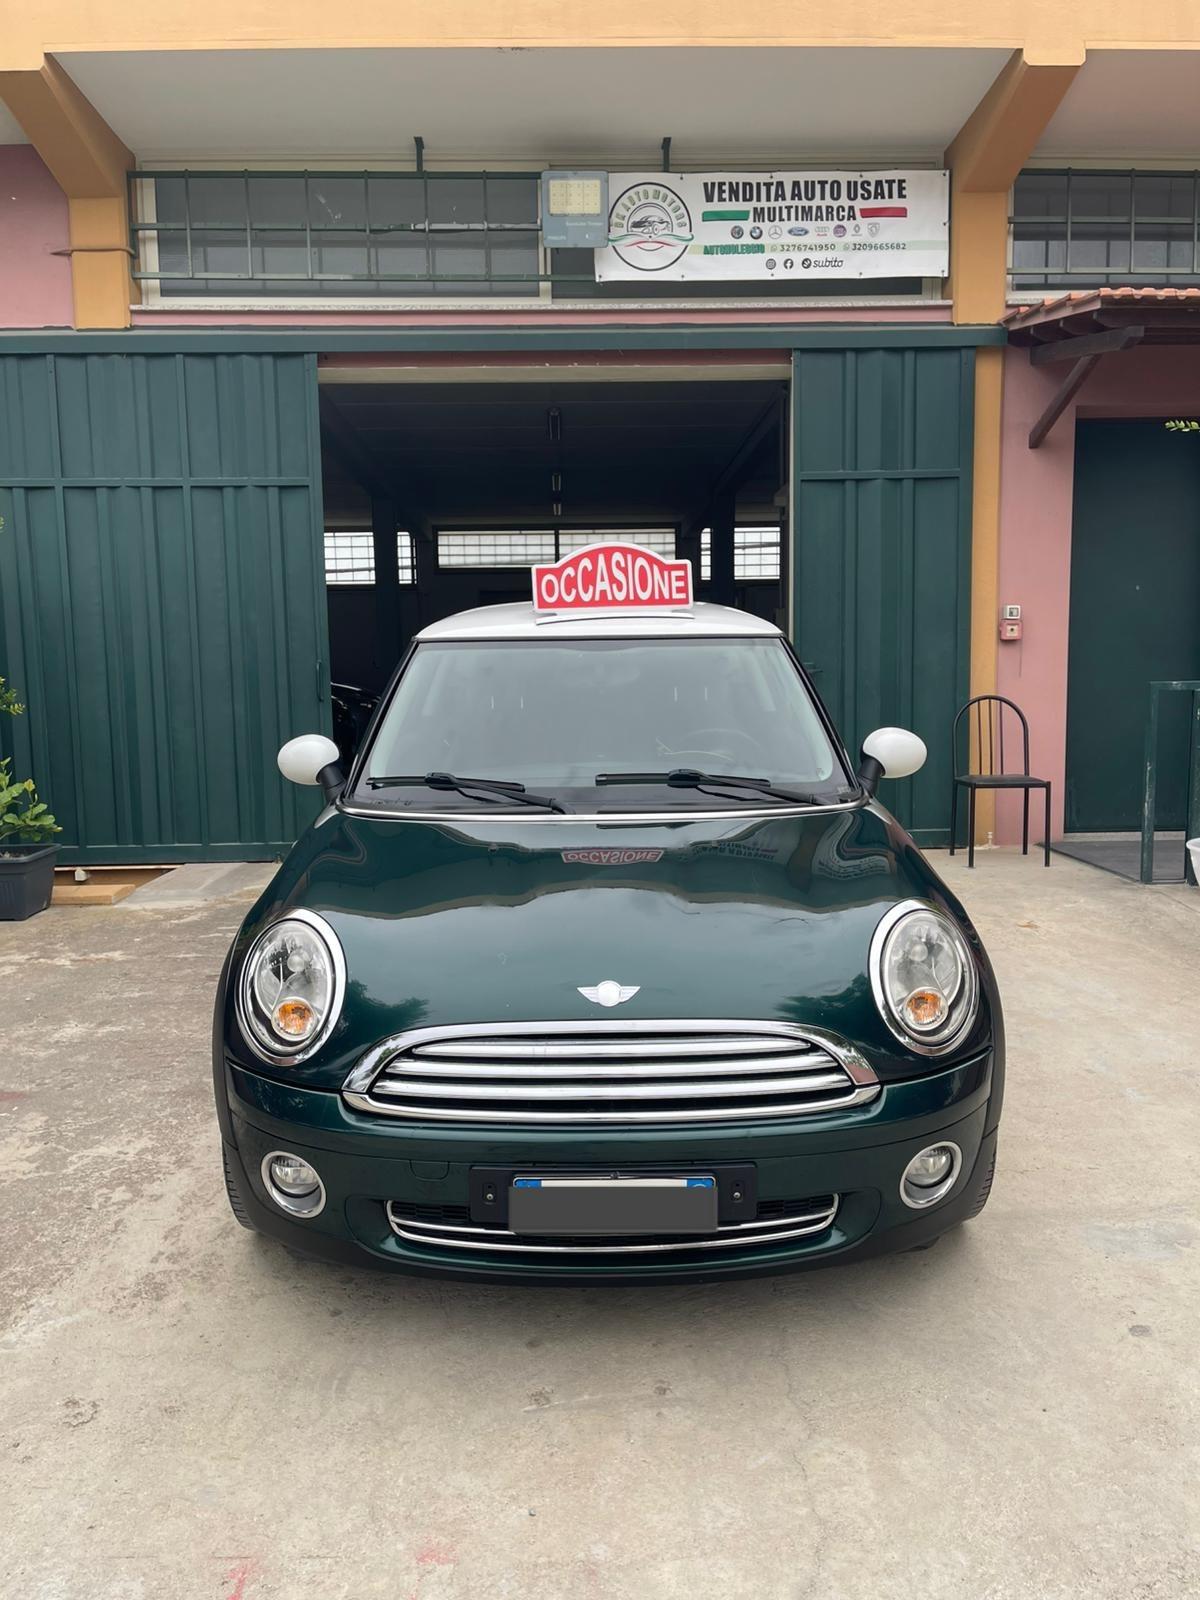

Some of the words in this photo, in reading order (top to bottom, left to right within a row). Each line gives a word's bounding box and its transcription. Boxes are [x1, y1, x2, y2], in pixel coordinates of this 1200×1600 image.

[703, 181, 786, 203] VENDITA
[790, 180, 842, 201] AUTO
[846, 179, 907, 200] USATE
[752, 205, 857, 223] MULTIMARCA
[780, 243, 836, 252] 3276741950
[852, 242, 907, 251] 3209665682
[812, 257, 844, 269] subito
[541, 552, 687, 604] OCCASIONE
